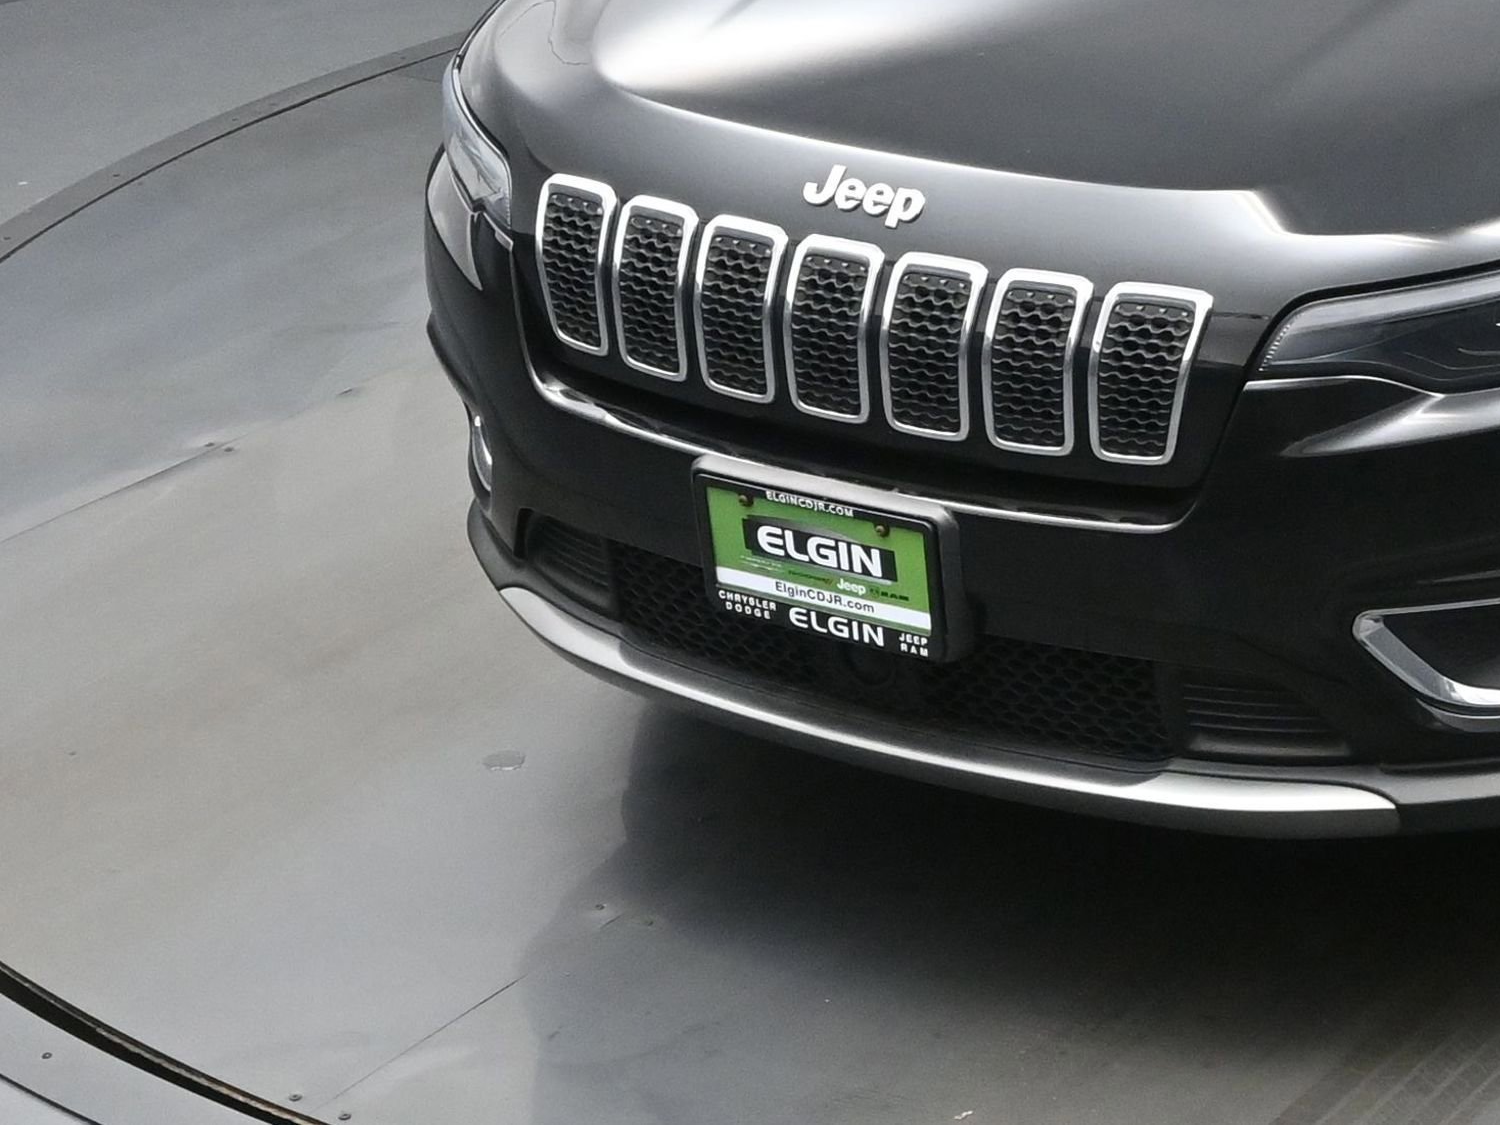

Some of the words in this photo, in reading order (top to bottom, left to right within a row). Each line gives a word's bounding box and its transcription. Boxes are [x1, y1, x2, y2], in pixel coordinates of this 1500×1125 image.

[803, 164, 926, 229] Jeep
[765, 490, 855, 517] ELGINCDJR.COM
[757, 525, 883, 578] ELGIN
[775, 581, 875, 614] ElginCDJR.com
[836, 578, 867, 596] Jeep
[718, 589, 777, 612] CHRYSLER
[725, 601, 771, 620] DODGE
[789, 607, 885, 647] ELGIN
[898, 632, 929, 646] JEEP
[900, 642, 929, 657] RAM
